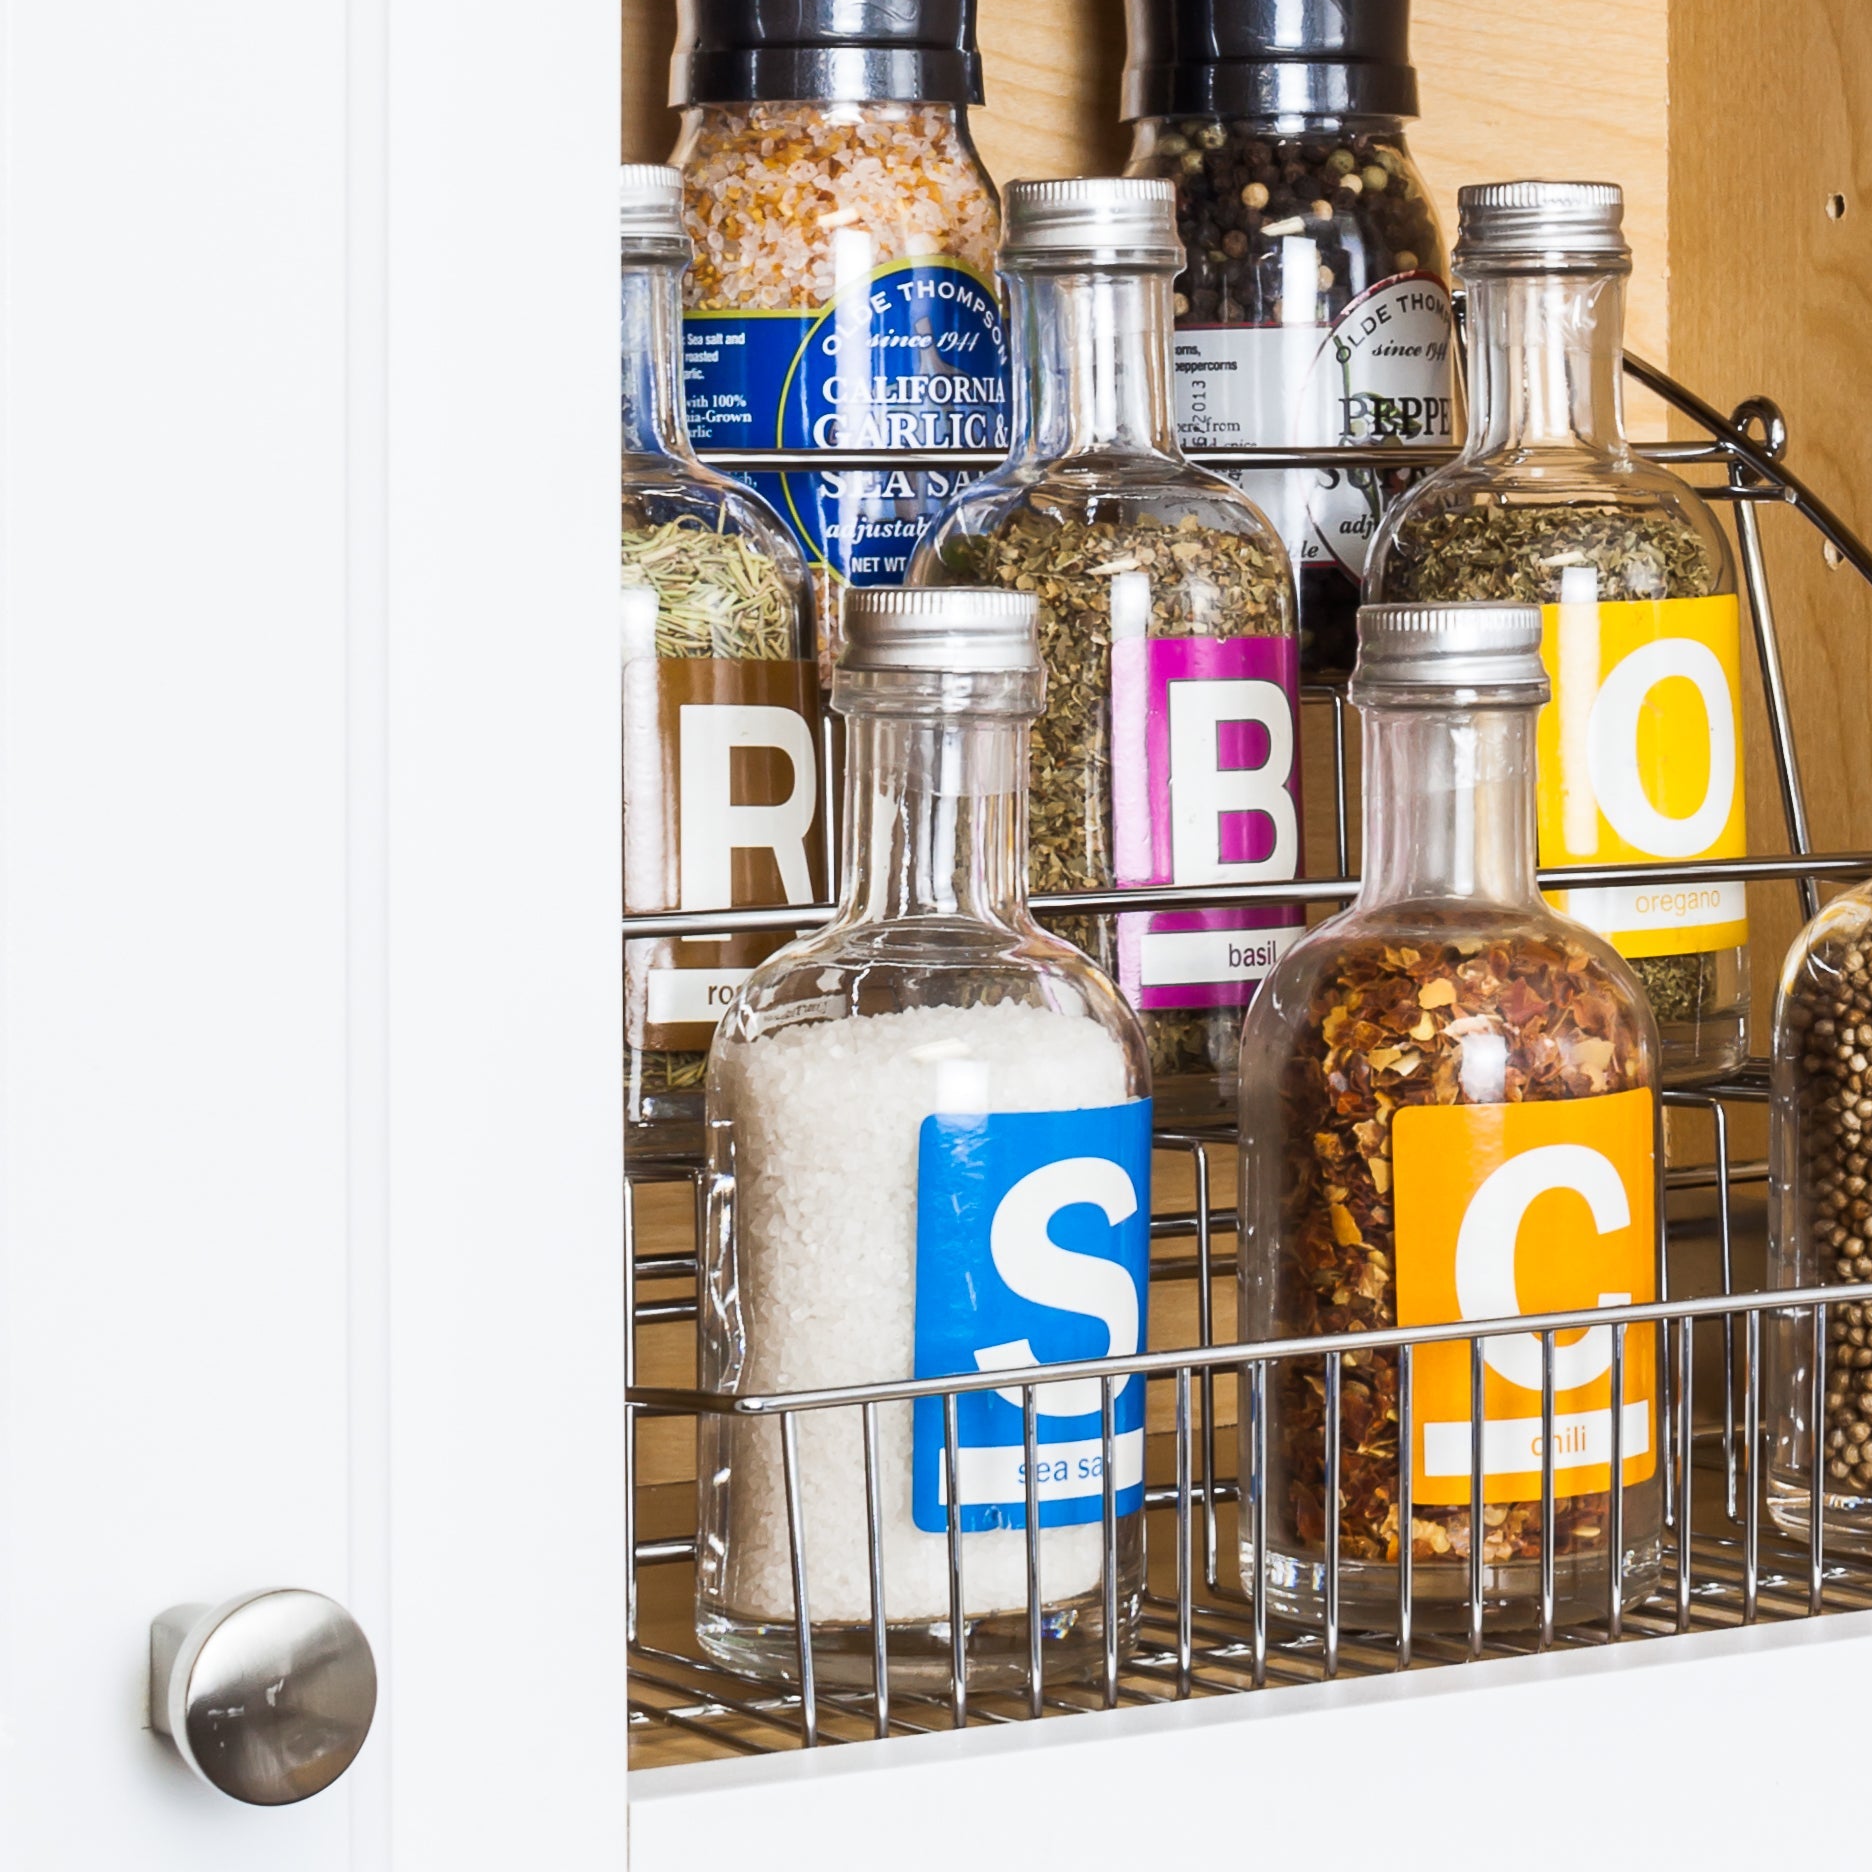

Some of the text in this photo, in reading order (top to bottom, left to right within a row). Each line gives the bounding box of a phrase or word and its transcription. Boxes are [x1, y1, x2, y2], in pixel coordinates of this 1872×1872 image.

[822, 279, 1009, 366] OLDE THOMPSON
[1336, 304, 1392, 364] OLDE
[687, 332, 745, 346] Sea salt and
[865, 329, 980, 352] since 1944
[1372, 339, 1422, 358] since
[712, 394, 747, 408] 100%
[822, 376, 1006, 404] CALIFORNIA
[813, 412, 1009, 449] GARLIC &
[818, 471, 915, 498] SEA
[852, 557, 880, 573] NET
[1587, 637, 1736, 858] O
[1168, 679, 1298, 885] B
[680, 705, 817, 941] R
[1635, 889, 1721, 916] oregano
[1229, 941, 1277, 968] basil
[1455, 1144, 1632, 1392] C
[973, 1156, 1139, 1418] S
